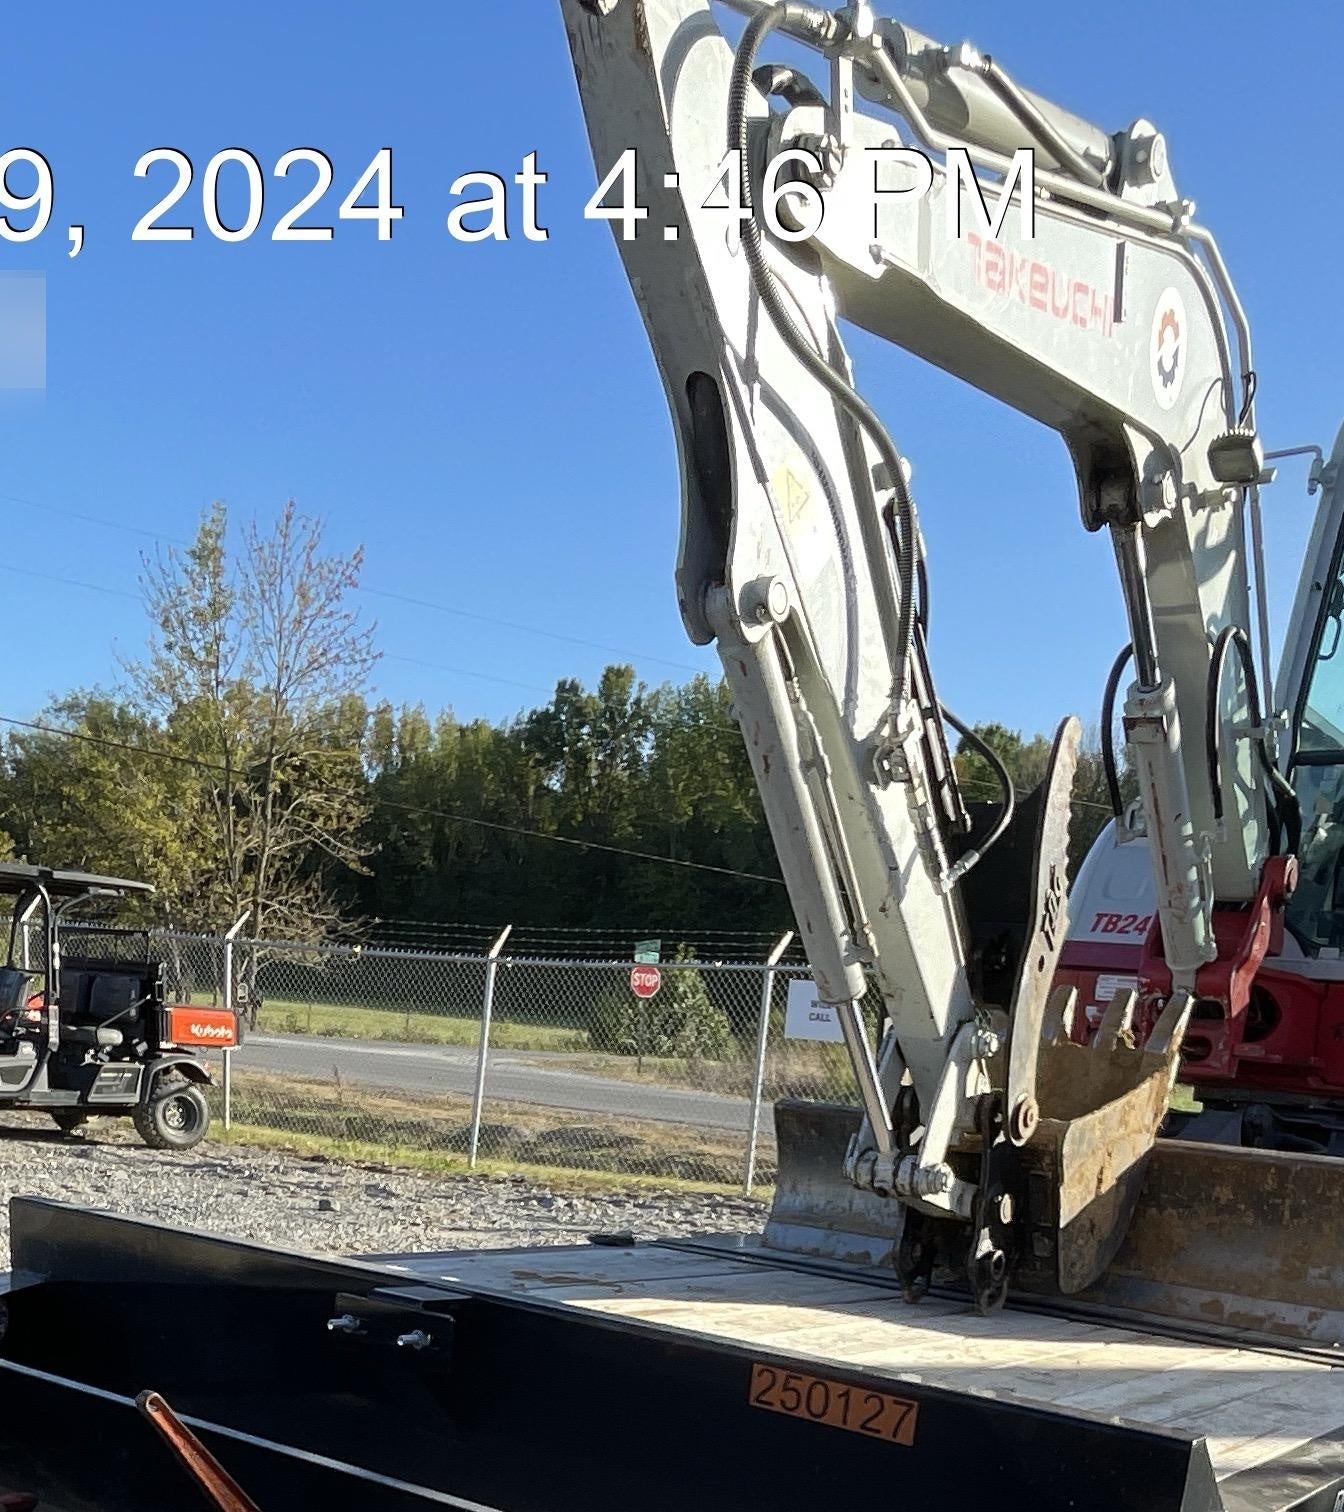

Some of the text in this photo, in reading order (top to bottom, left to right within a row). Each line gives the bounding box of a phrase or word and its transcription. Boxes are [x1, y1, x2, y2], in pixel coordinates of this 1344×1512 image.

[633, 971, 659, 988] STOP
[190, 1023, 233, 1039] Kubota
[755, 1367, 916, 1439] 250127
